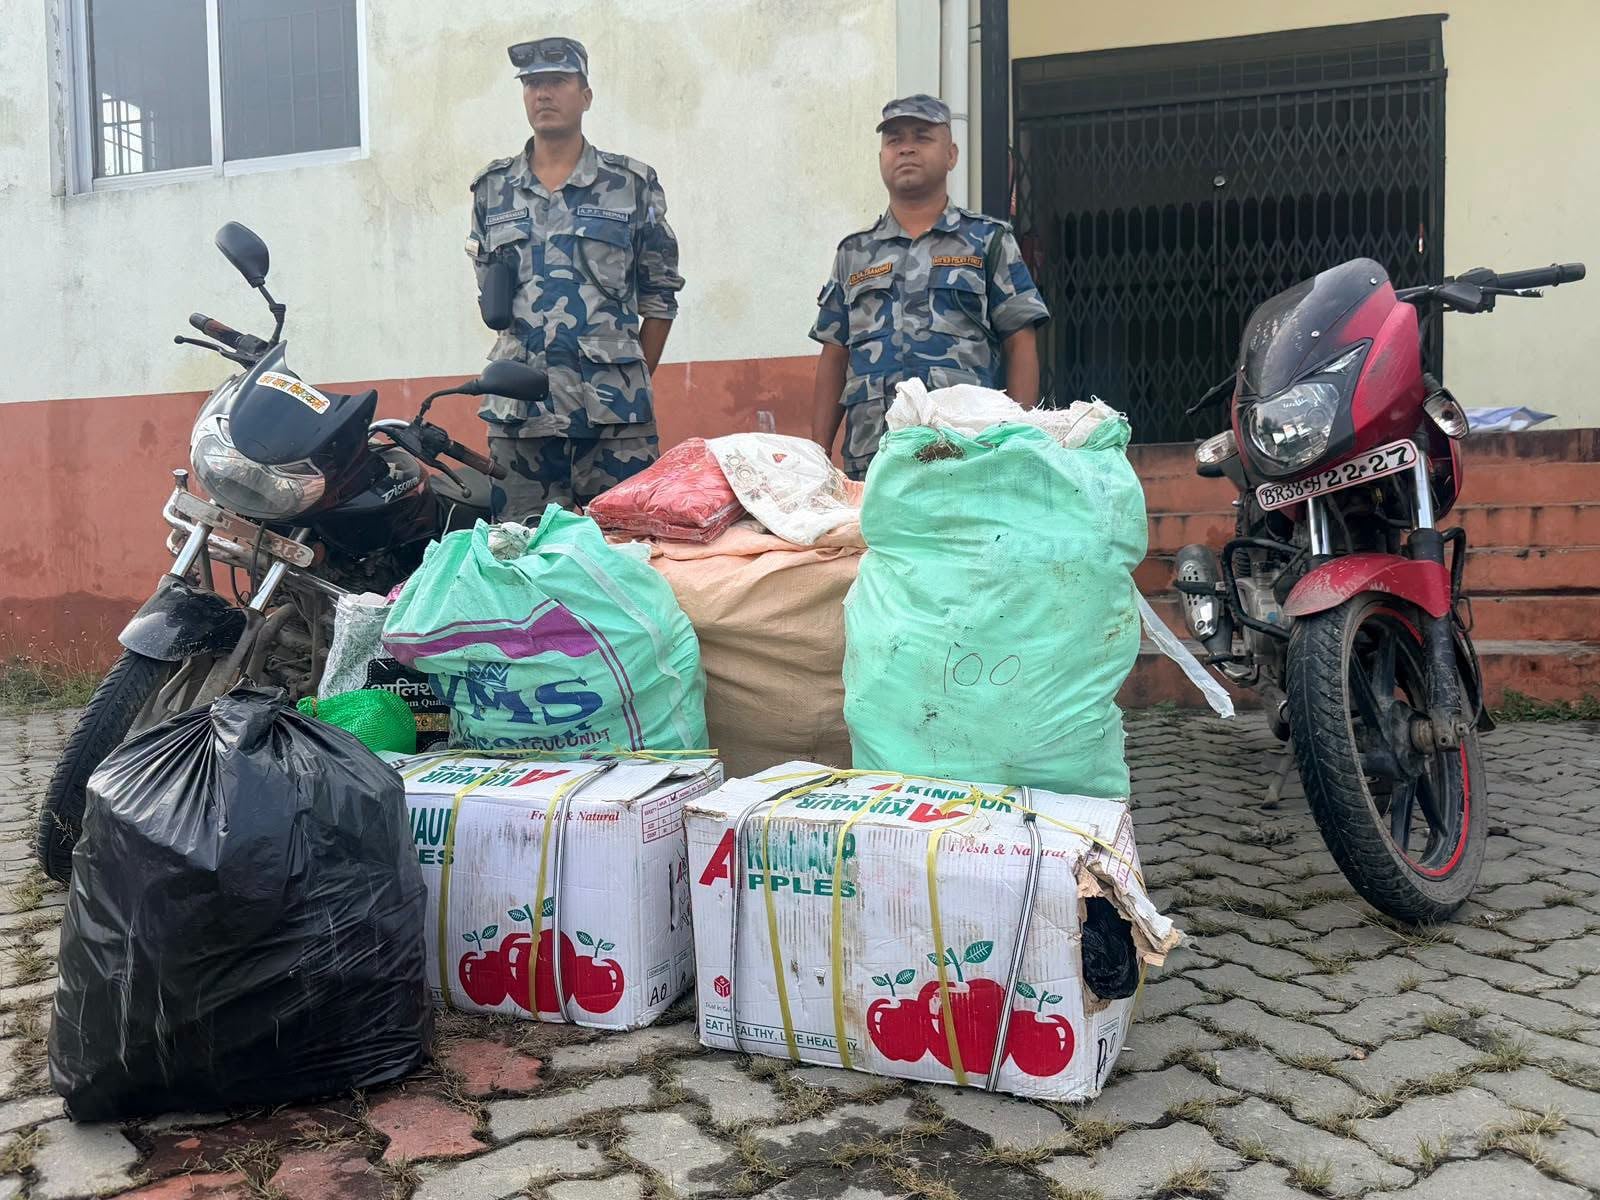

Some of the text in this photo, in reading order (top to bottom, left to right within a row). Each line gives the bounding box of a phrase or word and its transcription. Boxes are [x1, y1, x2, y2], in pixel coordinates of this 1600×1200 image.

[943, 645, 1022, 694] 100
[428, 671, 604, 727] VMS
[530, 810, 560, 821] Frh
[577, 811, 620, 822] Natural
[993, 843, 1006, 856] &
[1010, 844, 1066, 858] Naural
[705, 1018, 724, 1032] EAT
[781, 1032, 804, 1044] LE
[806, 1035, 858, 1051] HEALY
